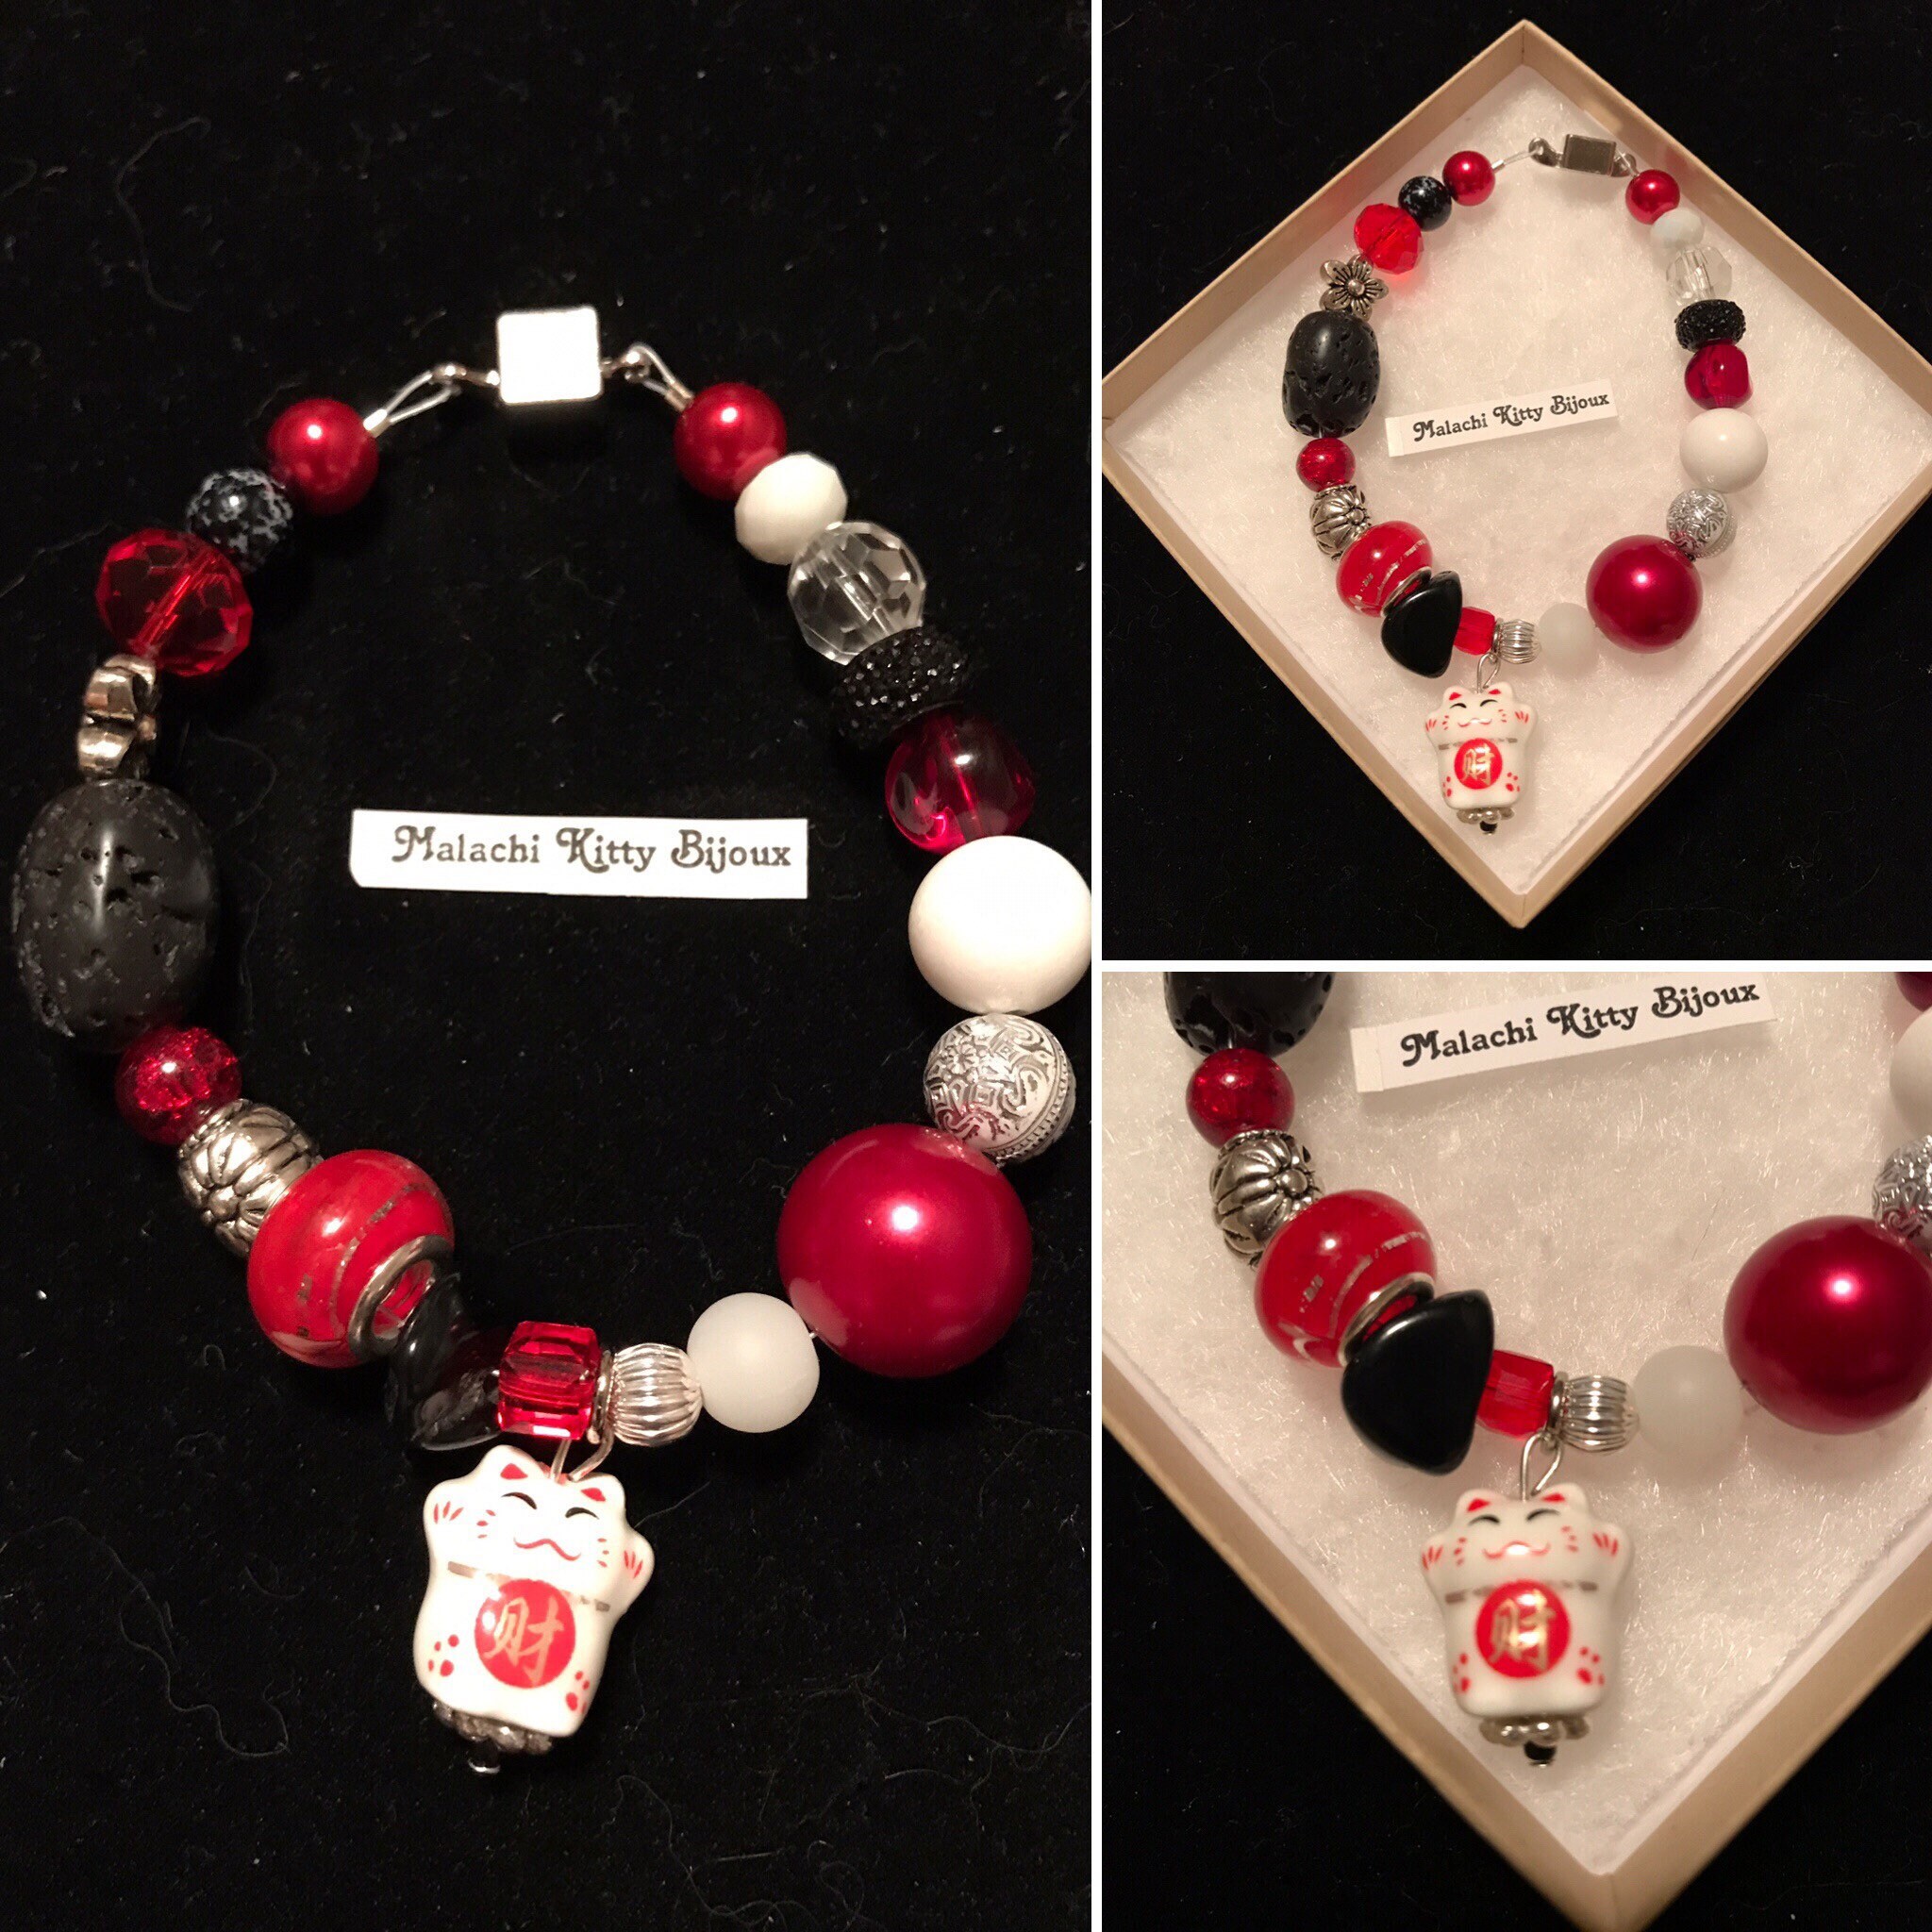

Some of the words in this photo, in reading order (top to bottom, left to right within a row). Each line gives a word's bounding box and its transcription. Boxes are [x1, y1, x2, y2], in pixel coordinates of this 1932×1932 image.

[1412, 413, 1489, 442] Malachi
[1492, 404, 1543, 426] Kitty
[1550, 394, 1610, 416] Bijoux
[391, 824, 541, 864] Malachi
[556, 827, 657, 874] Kitty
[671, 828, 791, 874] Bijoux
[1400, 1017, 1538, 1068] Malachi
[1546, 1003, 1640, 1040] Kitty
[1651, 983, 1761, 1018] Bijoux
[483, 1594, 565, 1686] 财
